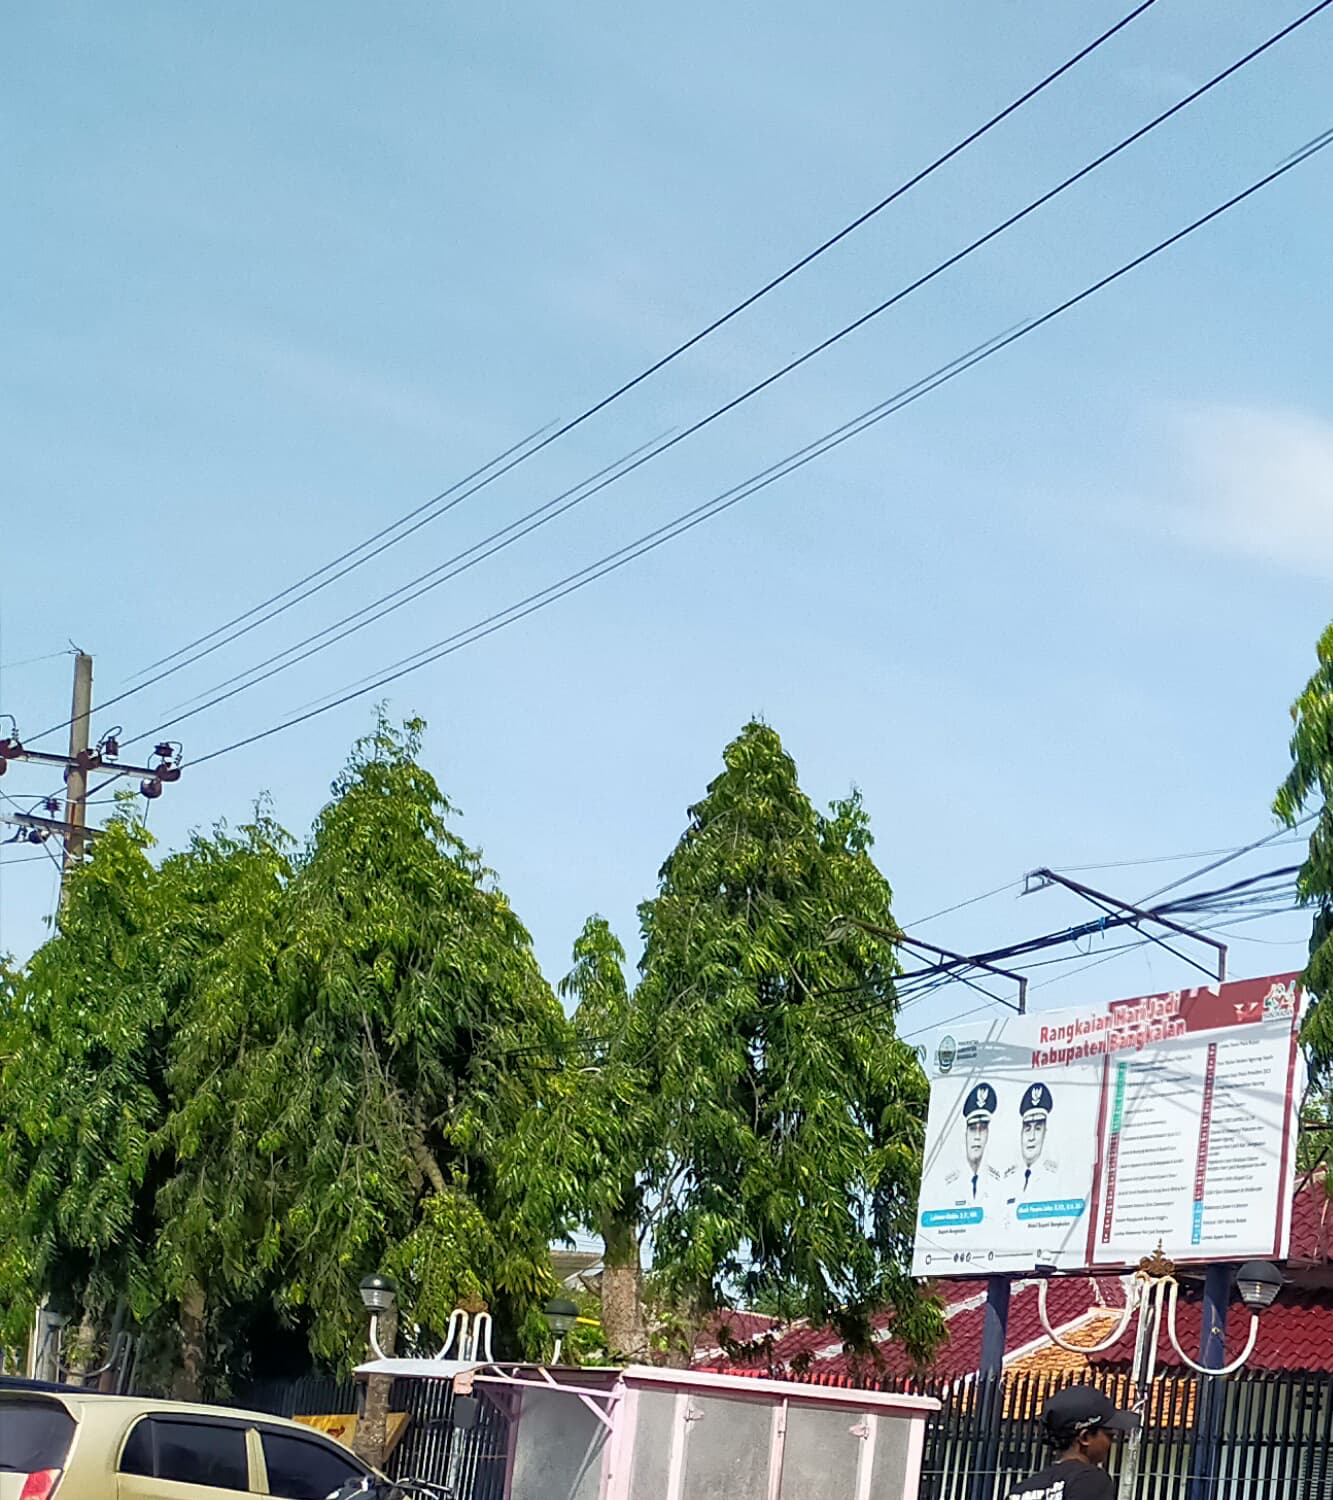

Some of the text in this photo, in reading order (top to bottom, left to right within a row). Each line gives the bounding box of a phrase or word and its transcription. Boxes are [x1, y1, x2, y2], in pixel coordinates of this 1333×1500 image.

[1031, 1037, 1106, 1069] Kabupaten
[1108, 1018, 1187, 1052] Bangkalan
[1039, 1012, 1112, 1044] Rangkaian
